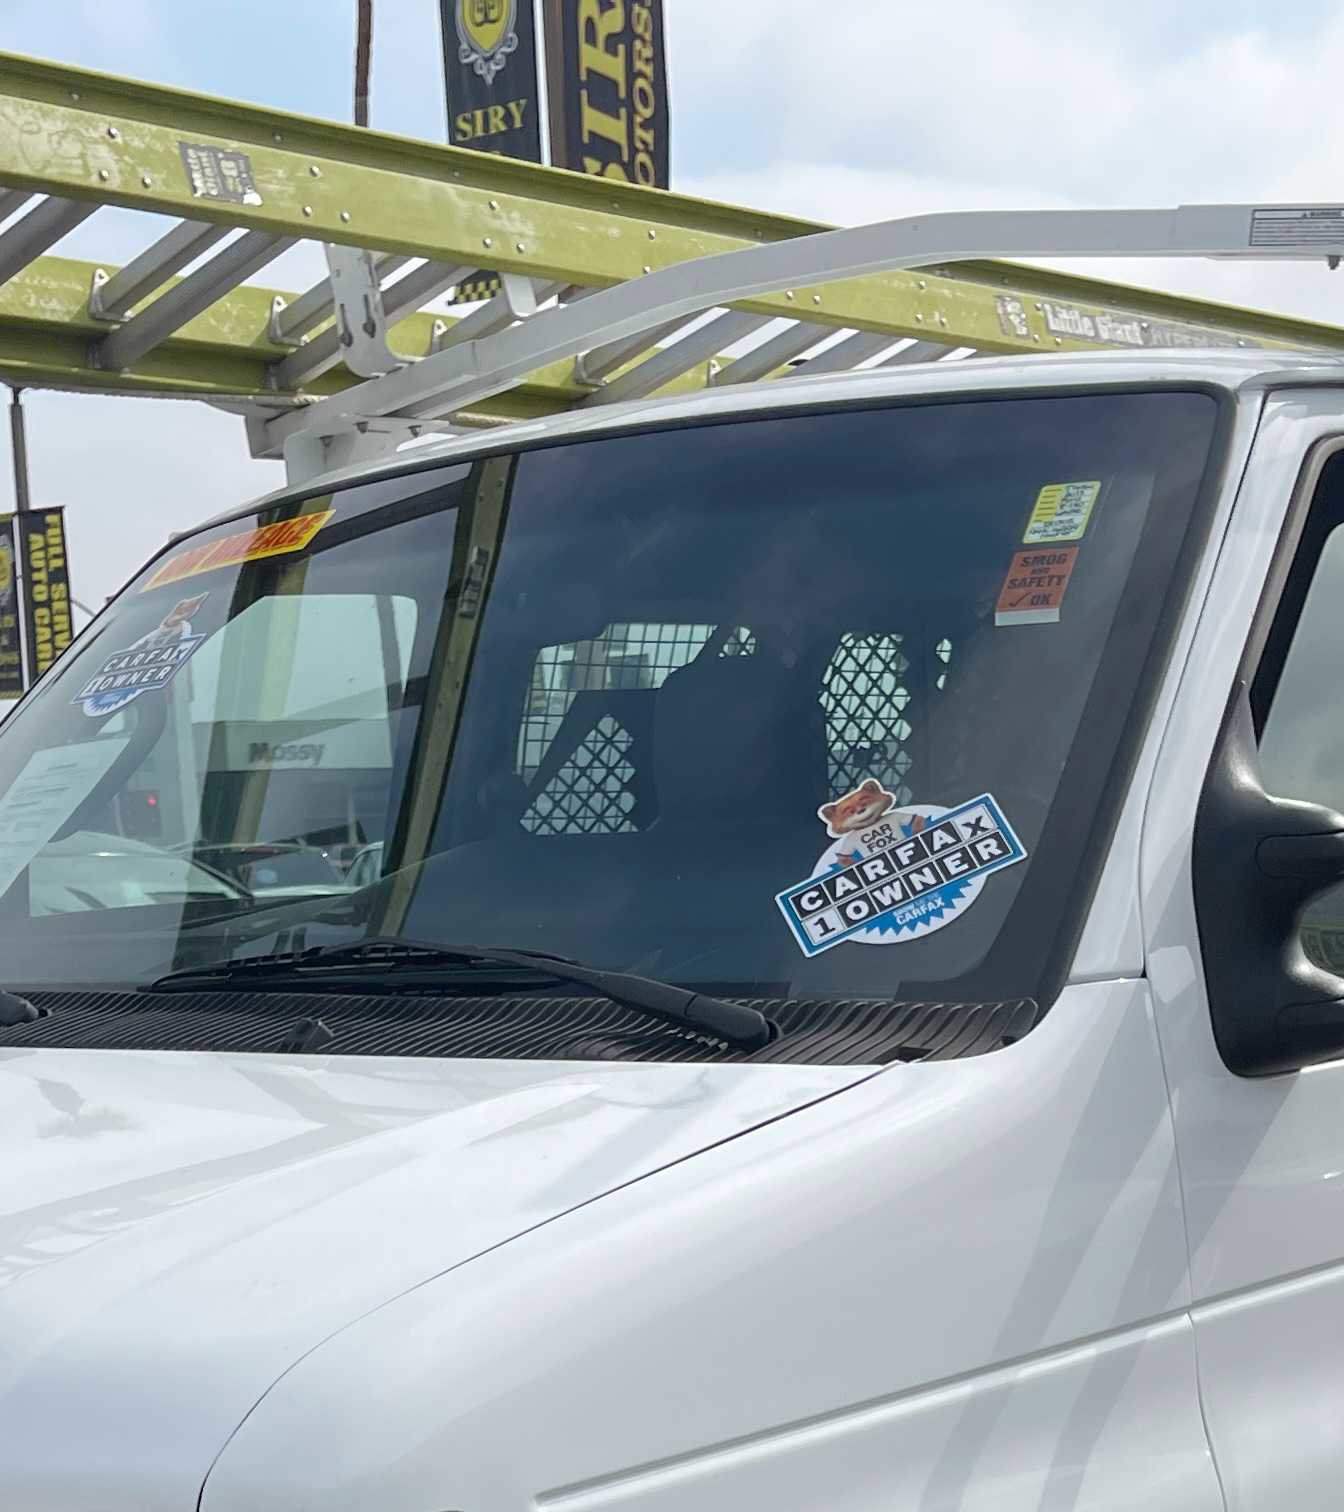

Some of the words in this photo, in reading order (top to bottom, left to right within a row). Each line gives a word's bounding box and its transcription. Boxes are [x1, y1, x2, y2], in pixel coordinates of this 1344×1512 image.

[455, 99, 528, 142] SIRY
[44, 513, 65, 572] FULL
[28, 532, 49, 603] AUTO
[1020, 553, 1069, 568] SMOG
[1007, 574, 1067, 590] SAFETY
[1029, 593, 1054, 607] OK
[50, 582, 74, 657] SERV
[103, 646, 188, 673] CARFAX
[98, 665, 172, 691] OWNER
[247, 742, 326, 767] Mossy
[860, 823, 893, 845] CAR
[867, 832, 898, 854] FOX
[799, 815, 992, 913] CARFAX
[813, 916, 837, 938] 1
[845, 839, 1003, 922] OWNER
[895, 896, 945, 926] CARFAX
